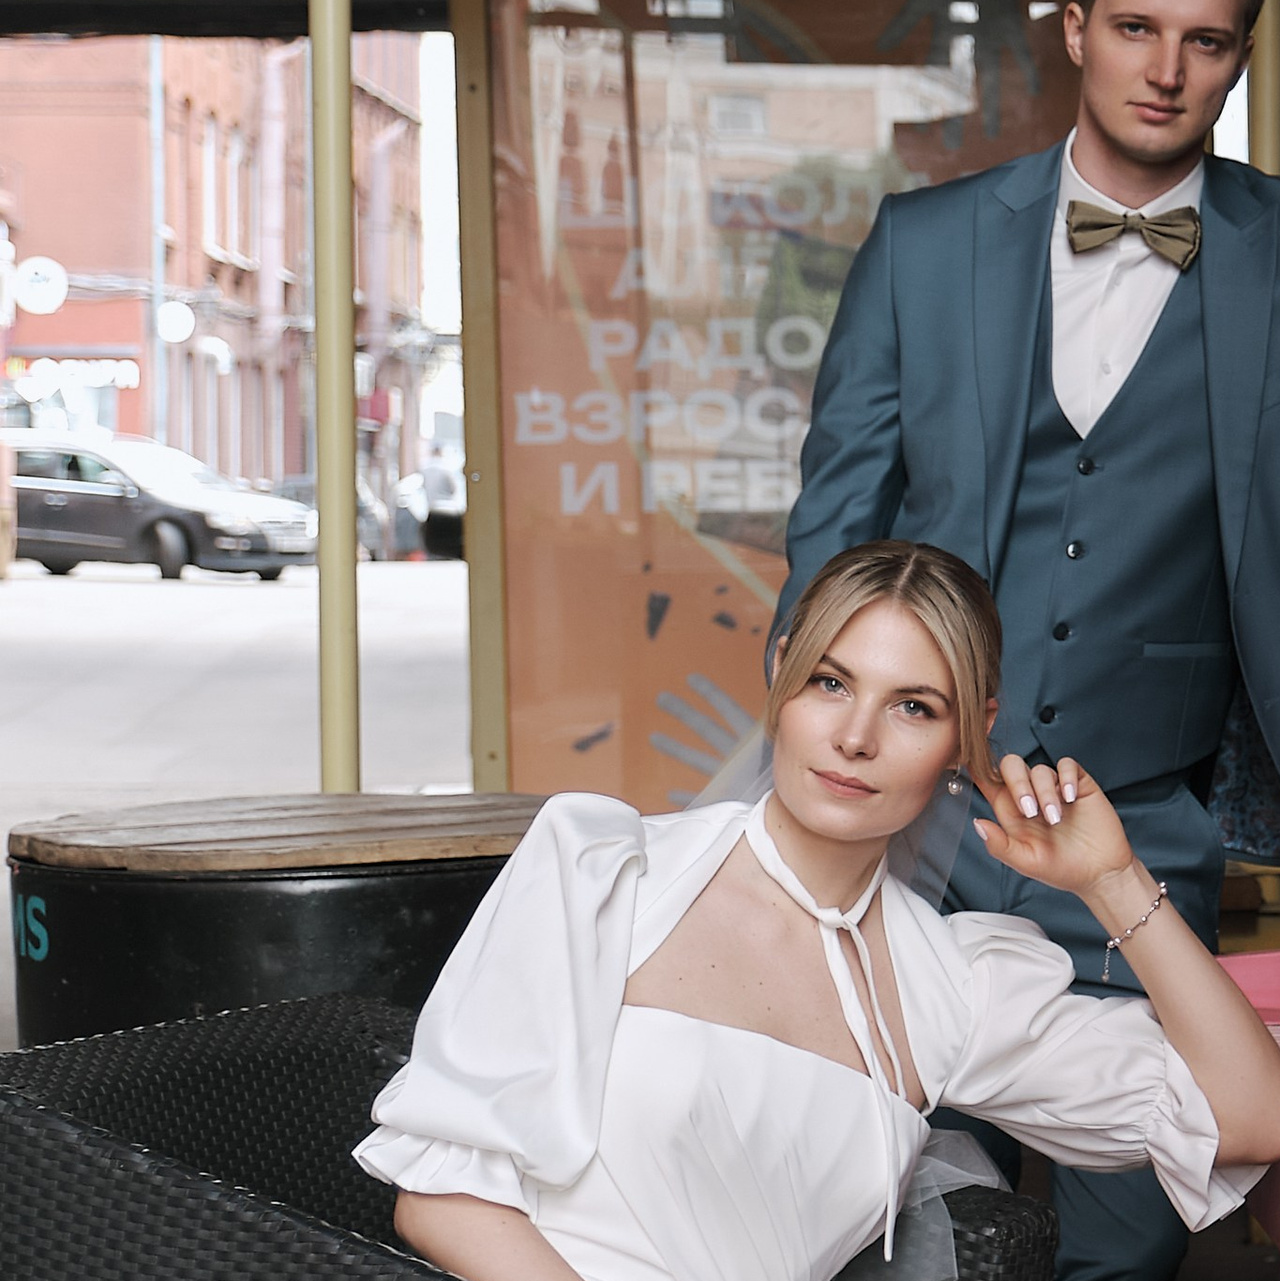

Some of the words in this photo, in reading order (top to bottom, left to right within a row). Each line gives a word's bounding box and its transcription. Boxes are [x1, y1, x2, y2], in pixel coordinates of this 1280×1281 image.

[587, 315, 826, 379] РАДО
[514, 388, 801, 447] ВЗРОС
[558, 461, 620, 516] И
[641, 459, 799, 514] РЕБ
